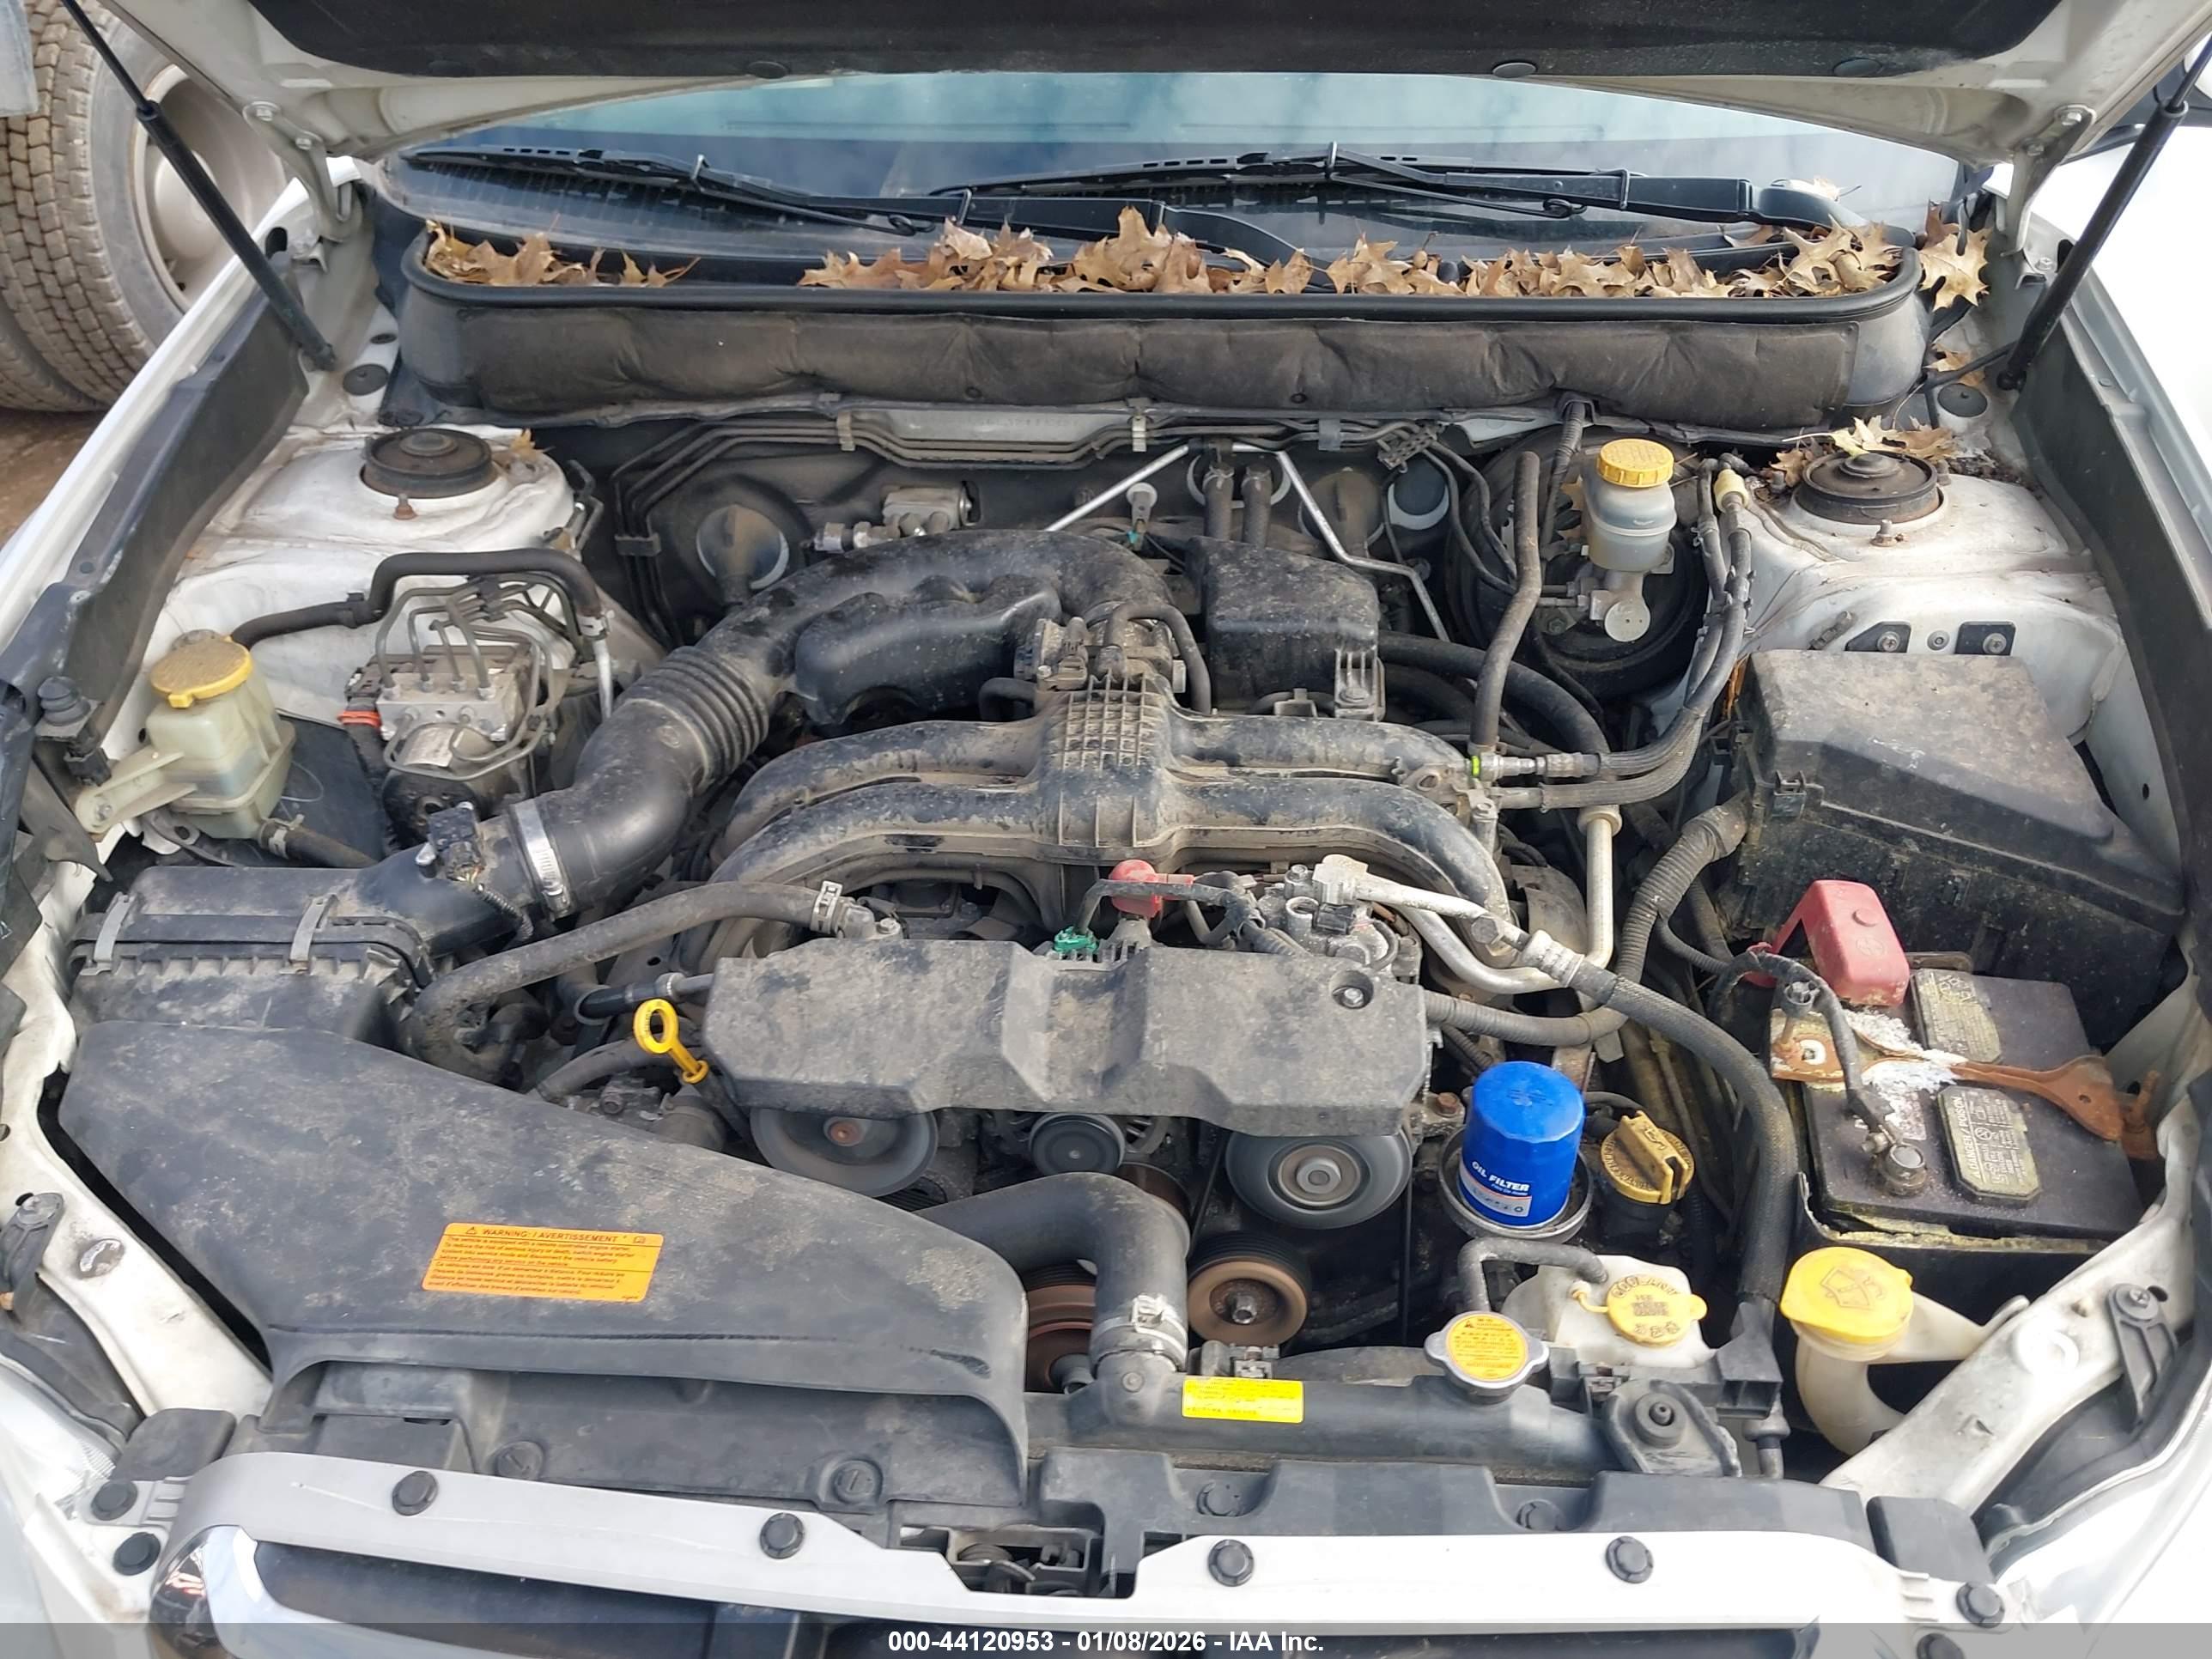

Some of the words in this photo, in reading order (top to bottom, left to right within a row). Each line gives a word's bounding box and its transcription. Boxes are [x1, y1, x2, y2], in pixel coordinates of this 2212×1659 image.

[1950, 1096, 1969, 1127] POISON
[1472, 1161, 1487, 1177] OIL
[1489, 1175, 1529, 1192] FILTER
[537, 1232, 619, 1242] AVERTISSEMENT
